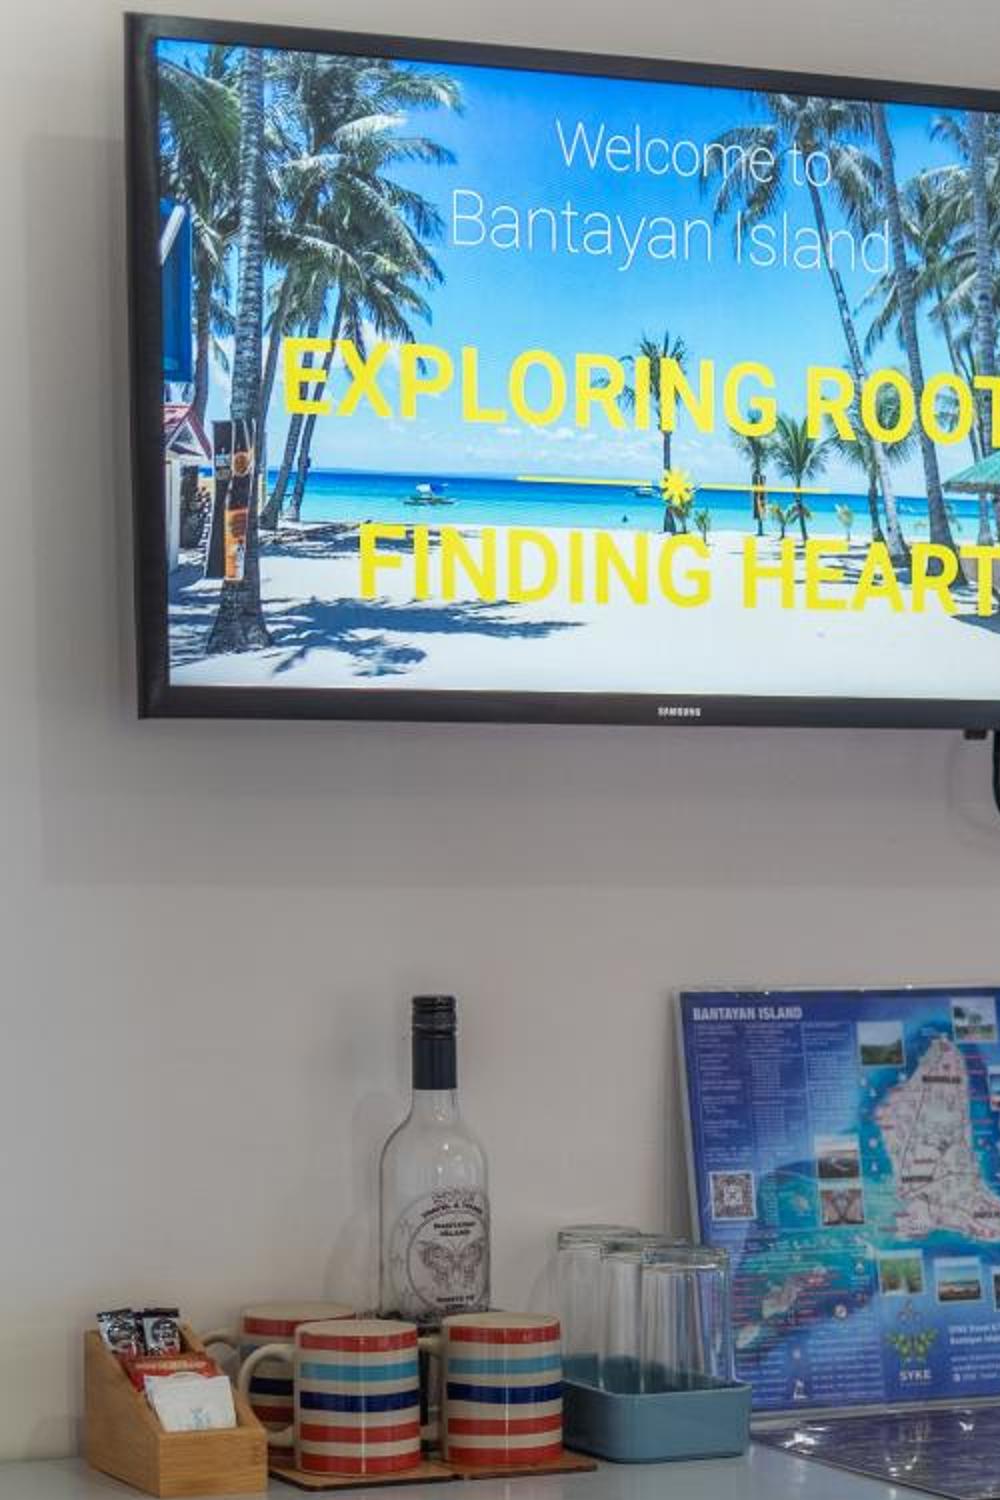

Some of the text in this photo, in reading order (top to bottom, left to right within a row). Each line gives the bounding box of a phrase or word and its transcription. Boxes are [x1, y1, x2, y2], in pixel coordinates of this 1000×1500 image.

[555, 117, 833, 188] Welcome to
[451, 189, 891, 274] Bantayan Island
[281, 337, 779, 438] EXPLORING
[358, 522, 713, 609] FINDING
[657, 706, 702, 717] SAMSUNG
[692, 1007, 803, 1022] BANTAYAN ISLAND
